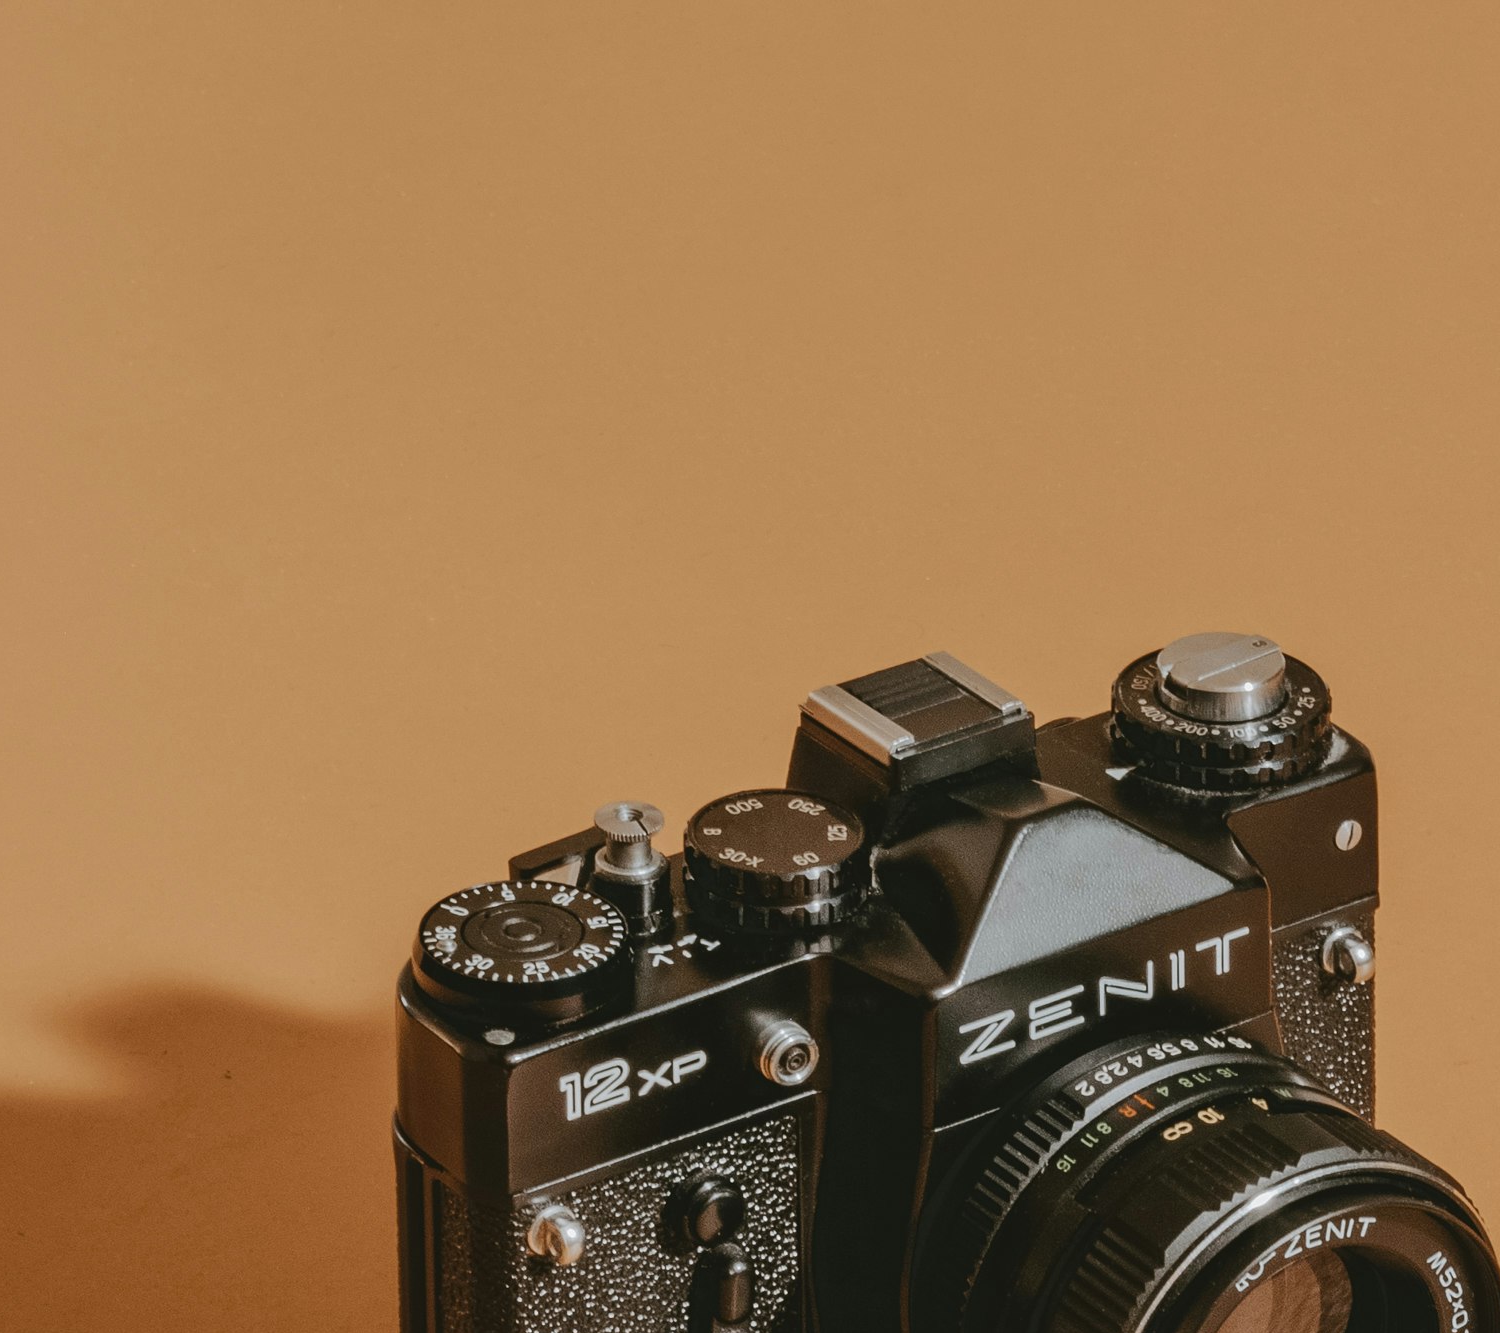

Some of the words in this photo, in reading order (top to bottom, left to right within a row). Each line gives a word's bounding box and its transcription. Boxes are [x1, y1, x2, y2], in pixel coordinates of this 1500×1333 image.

[1141, 705, 1167, 722] 400
[1174, 722, 1208, 736] 200
[1271, 716, 1296, 729] 50
[1298, 696, 1316, 709] 25
[725, 799, 763, 815] 500
[787, 799, 826, 816] 250
[703, 828, 722, 838] B
[827, 824, 847, 841] 125
[793, 850, 820, 867] 60
[551, 893, 571, 906] 10
[587, 915, 607, 930] 15
[573, 944, 599, 961] 20
[465, 953, 495, 970] 30
[523, 960, 550, 975] 25
[958, 925, 1250, 1066] ZENIT
[1147, 1042, 1182, 1060] 5,6
[1180, 1038, 1199, 1051] 8
[1126, 1054, 1143, 1068] 4
[1094, 1061, 1129, 1085] 2,8
[559, 1055, 632, 1122] 12
[637, 1050, 708, 1097] XP
[1074, 1080, 1096, 1097] 2
[1197, 1106, 1225, 1124] 10
[1284, 1217, 1377, 1259] ZENIT
